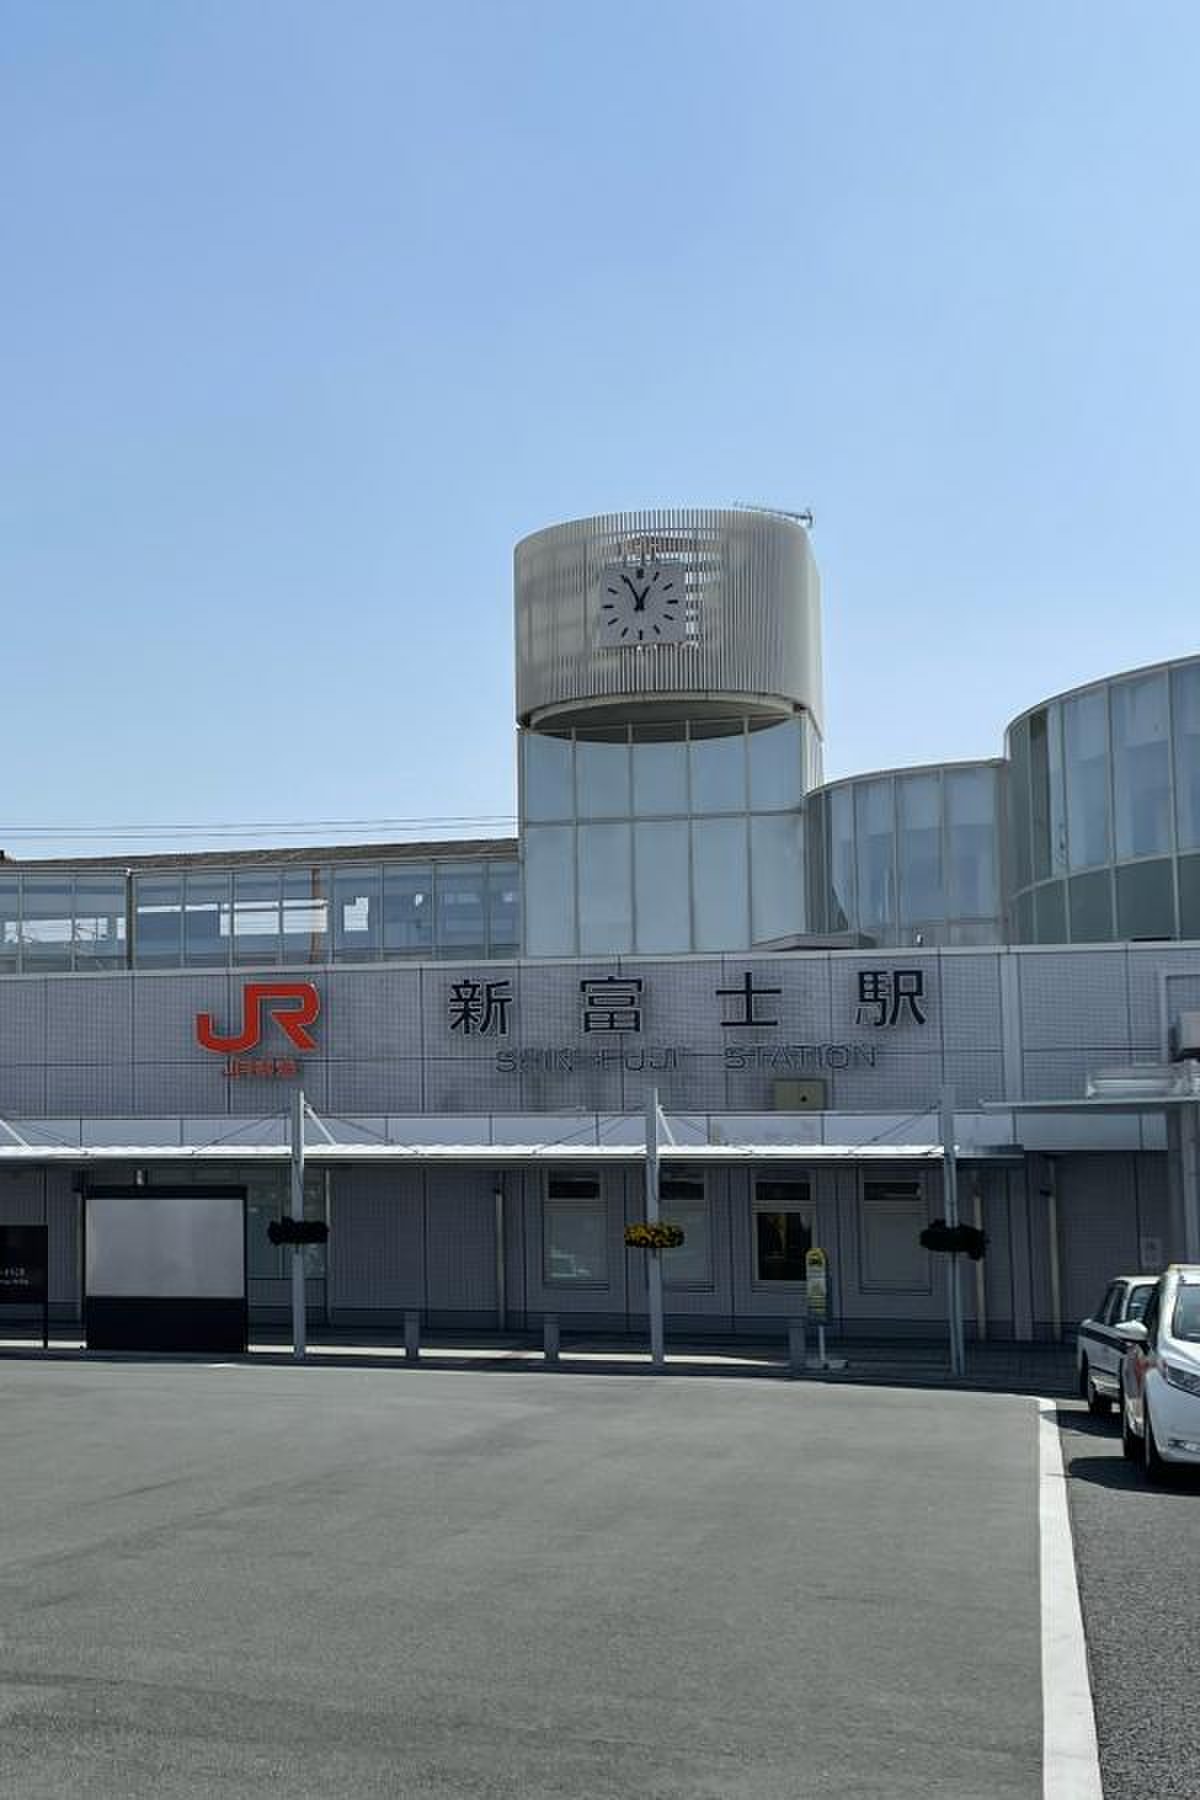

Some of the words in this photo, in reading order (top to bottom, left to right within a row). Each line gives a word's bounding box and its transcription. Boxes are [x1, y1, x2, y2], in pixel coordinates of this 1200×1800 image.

[195, 983, 319, 1053] JR
[448, 969, 927, 1036] 新富士駅
[723, 1043, 878, 1071] STATION
